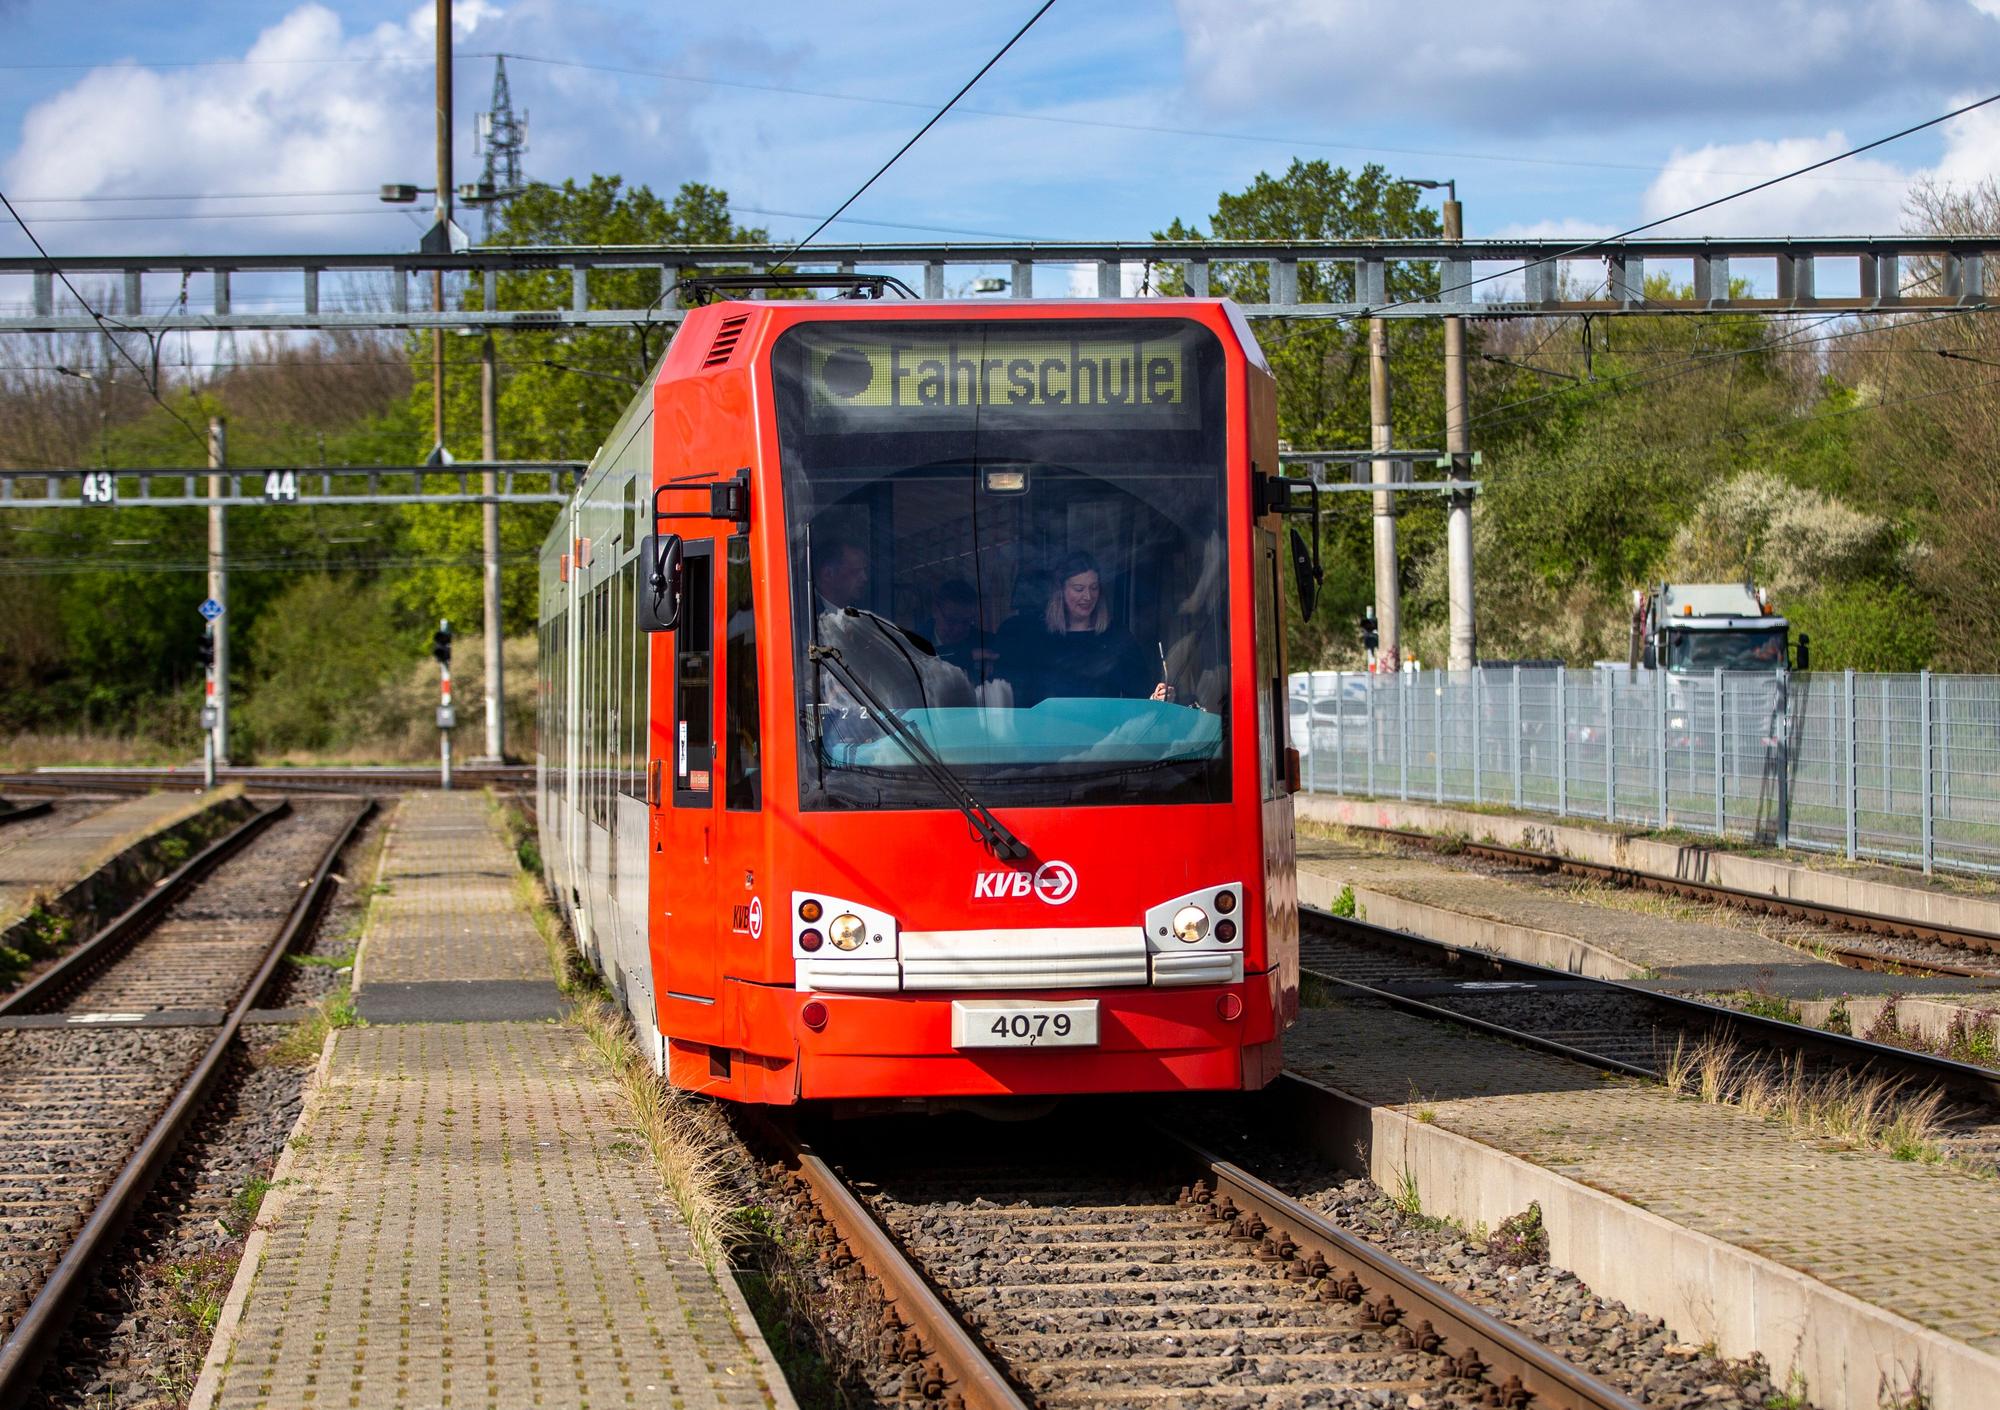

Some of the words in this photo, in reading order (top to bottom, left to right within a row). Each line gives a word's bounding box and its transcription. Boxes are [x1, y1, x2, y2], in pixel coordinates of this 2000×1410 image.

[891, 342, 1175, 405] Fahrschule
[83, 472, 113, 502] 43
[265, 471, 297, 500] 44
[974, 871, 1033, 898] KVB
[733, 904, 750, 929] KVB
[991, 1013, 1072, 1038] 4079
